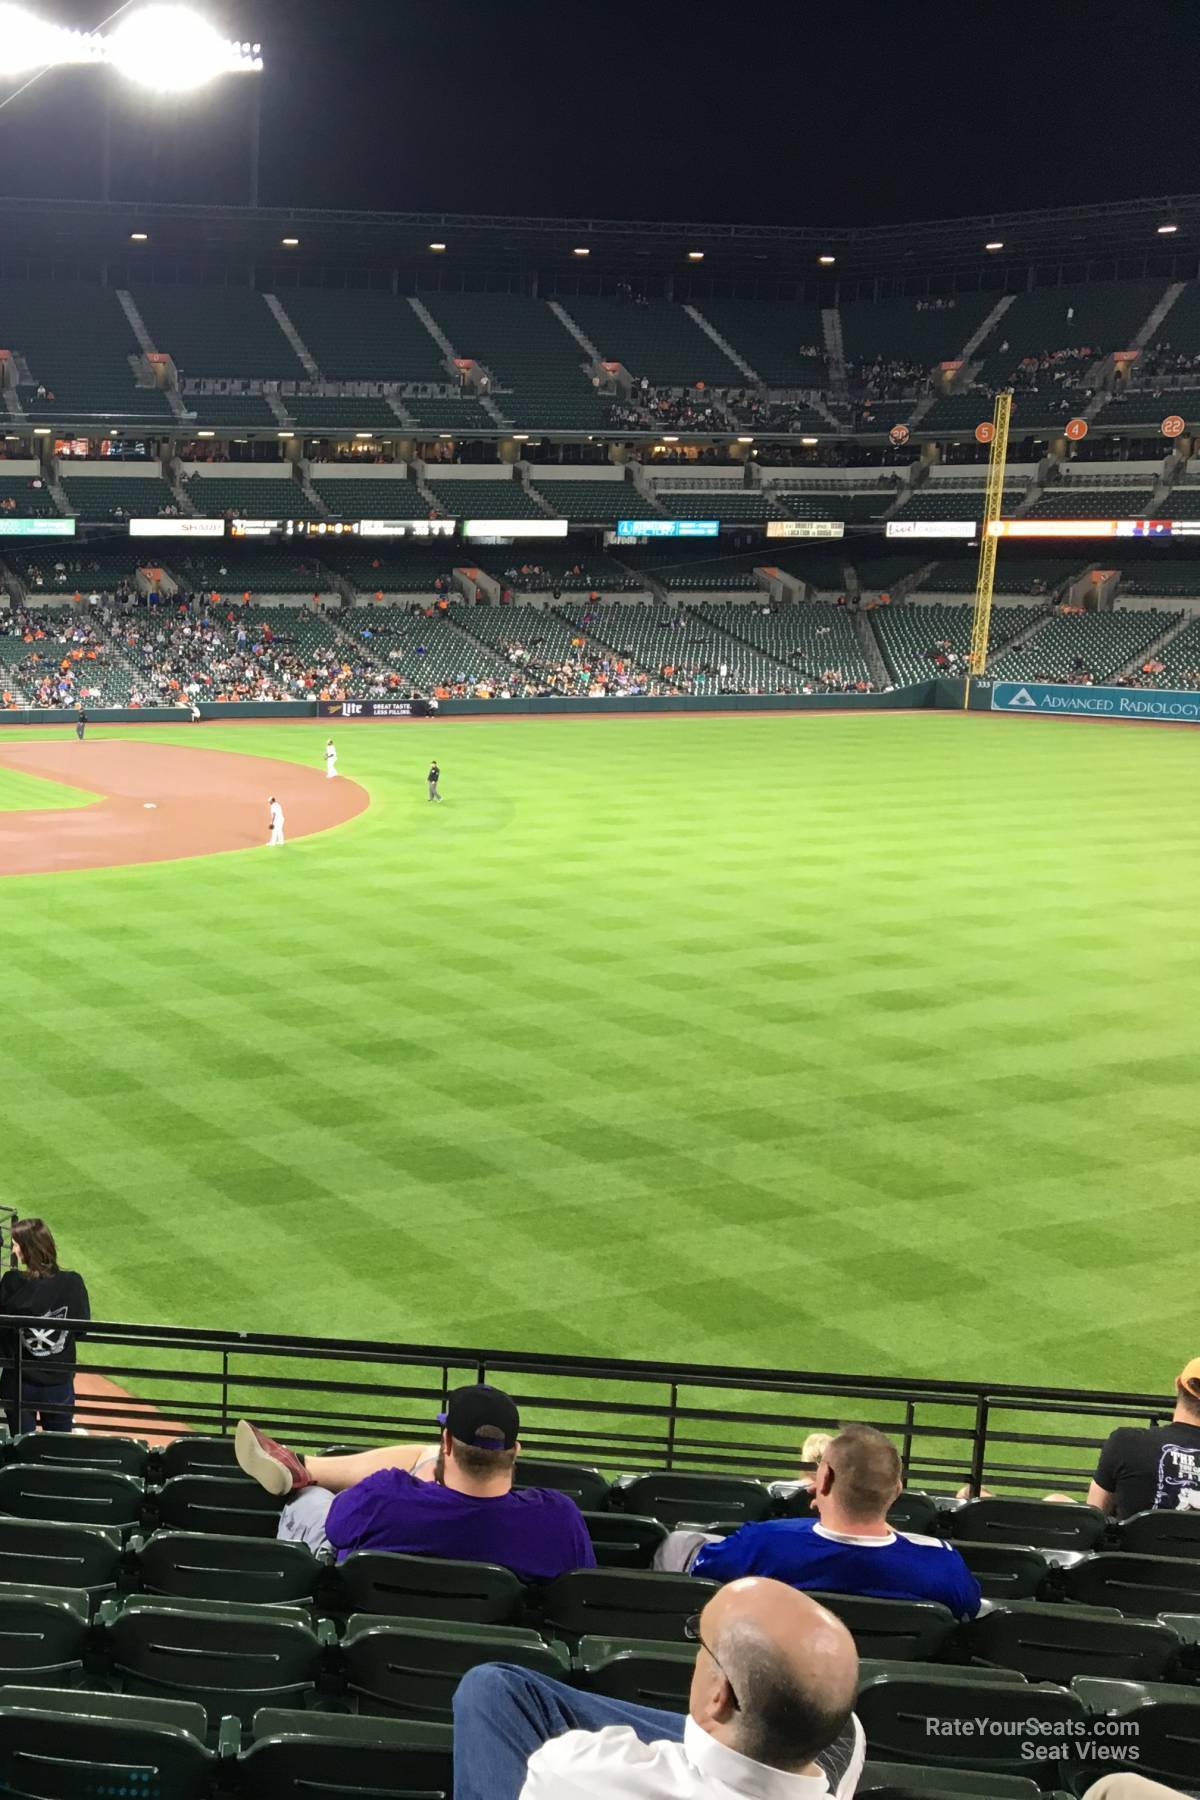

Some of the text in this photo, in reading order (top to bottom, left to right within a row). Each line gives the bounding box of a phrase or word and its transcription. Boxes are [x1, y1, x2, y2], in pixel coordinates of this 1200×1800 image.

[980, 426, 989, 438] 5
[1071, 423, 1080, 435] 4
[1164, 420, 1181, 432] 22
[341, 702, 363, 717] Lite
[1040, 694, 1200, 716] ADVANCED RADIOLOGY
[1170, 1451, 1195, 1466] THE
